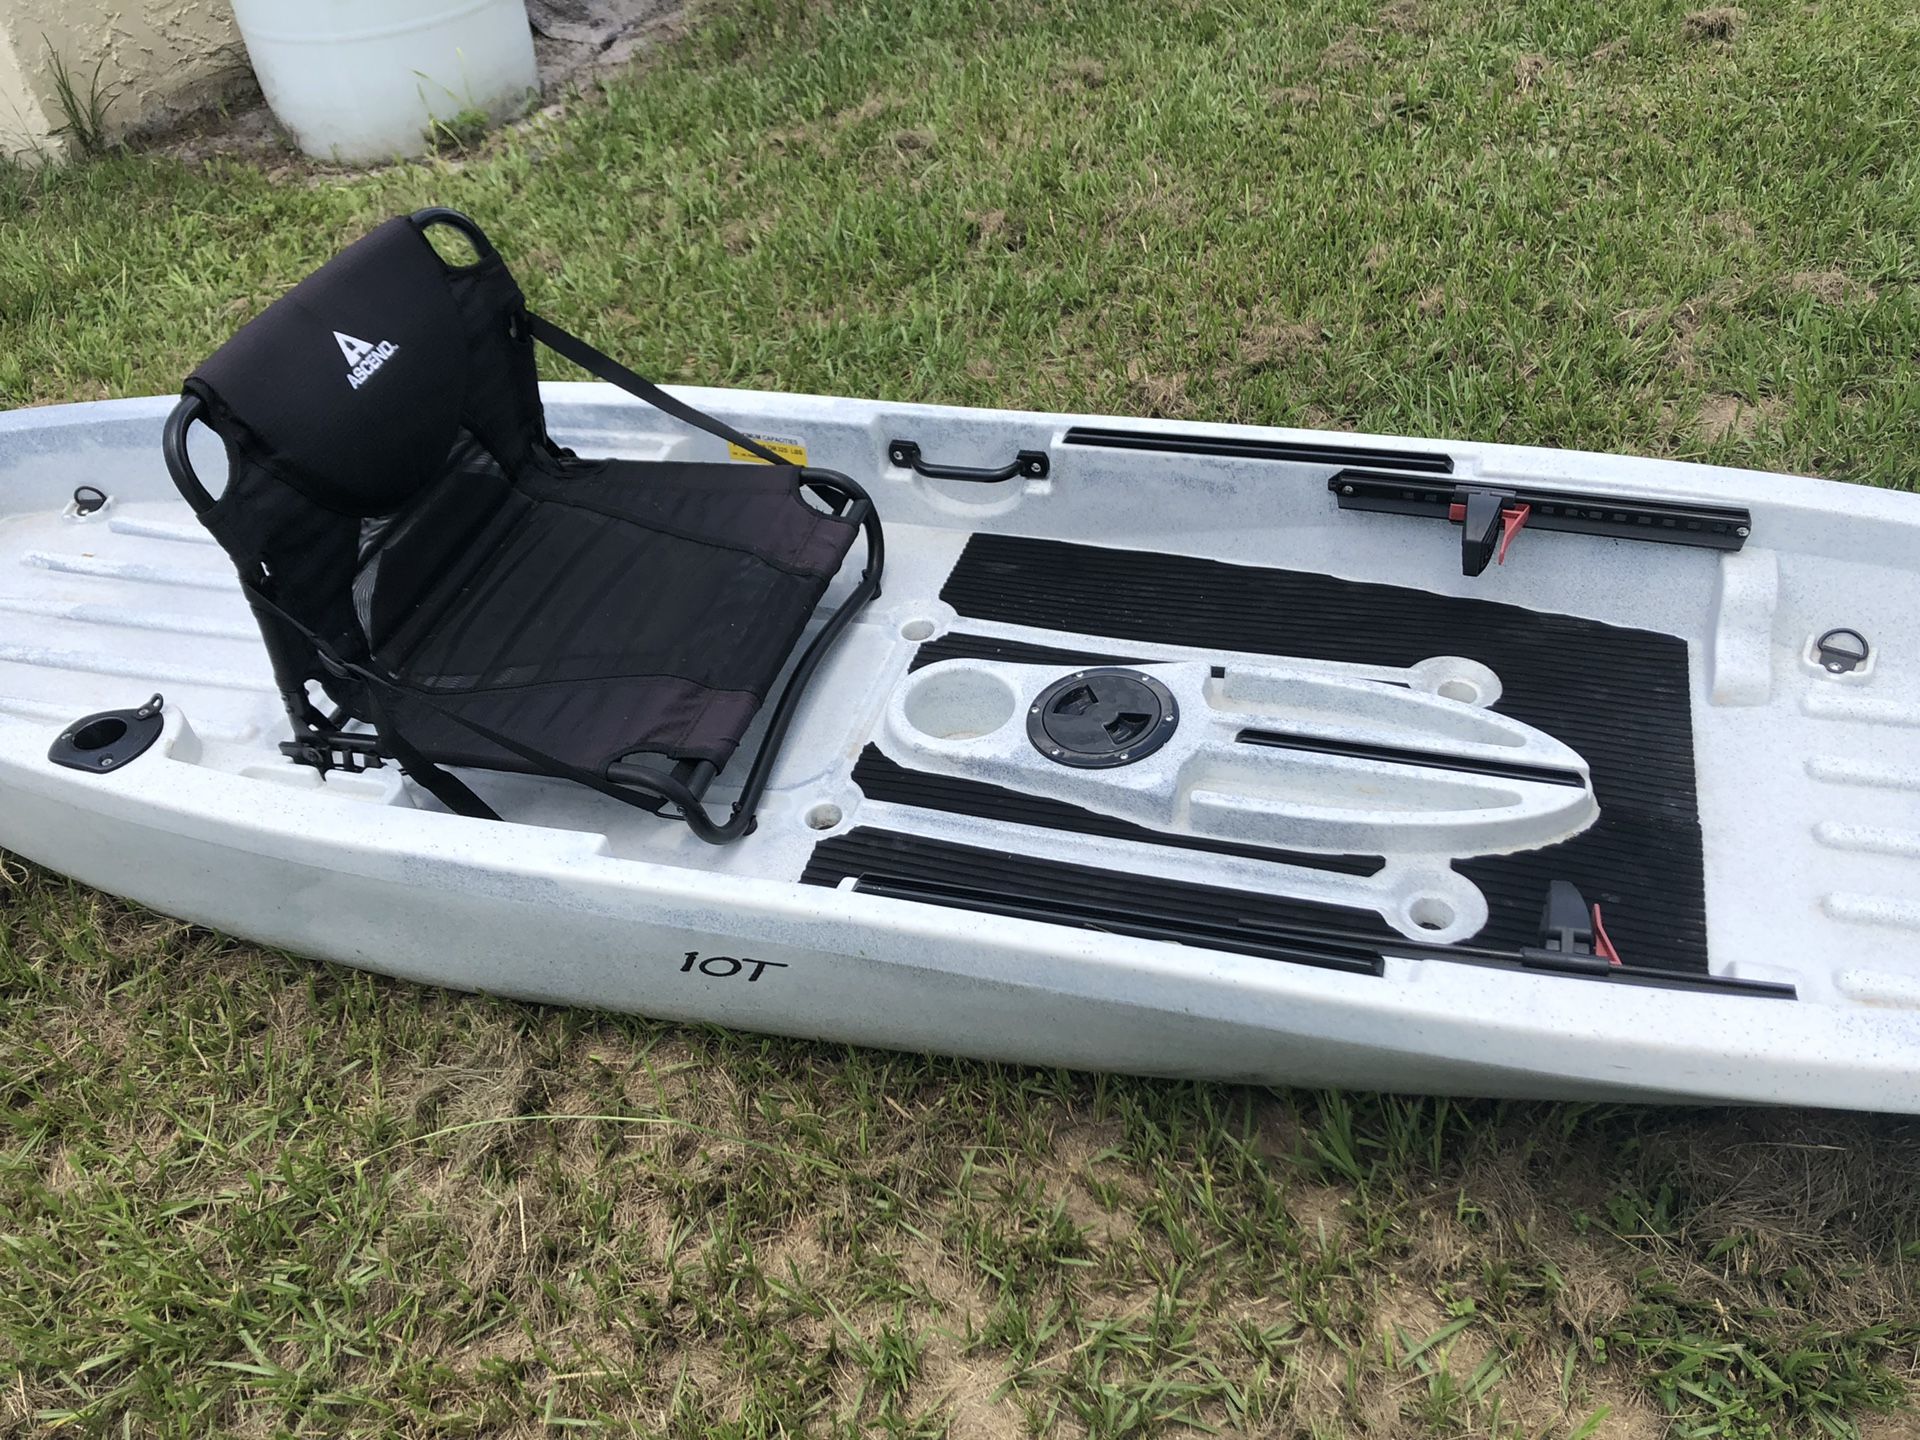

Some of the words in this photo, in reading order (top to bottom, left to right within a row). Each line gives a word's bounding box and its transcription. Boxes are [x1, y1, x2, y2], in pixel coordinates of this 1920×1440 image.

[763, 436, 798, 446] CAPACITIES
[791, 448, 803, 456] LBS
[680, 951, 789, 982] 10T
